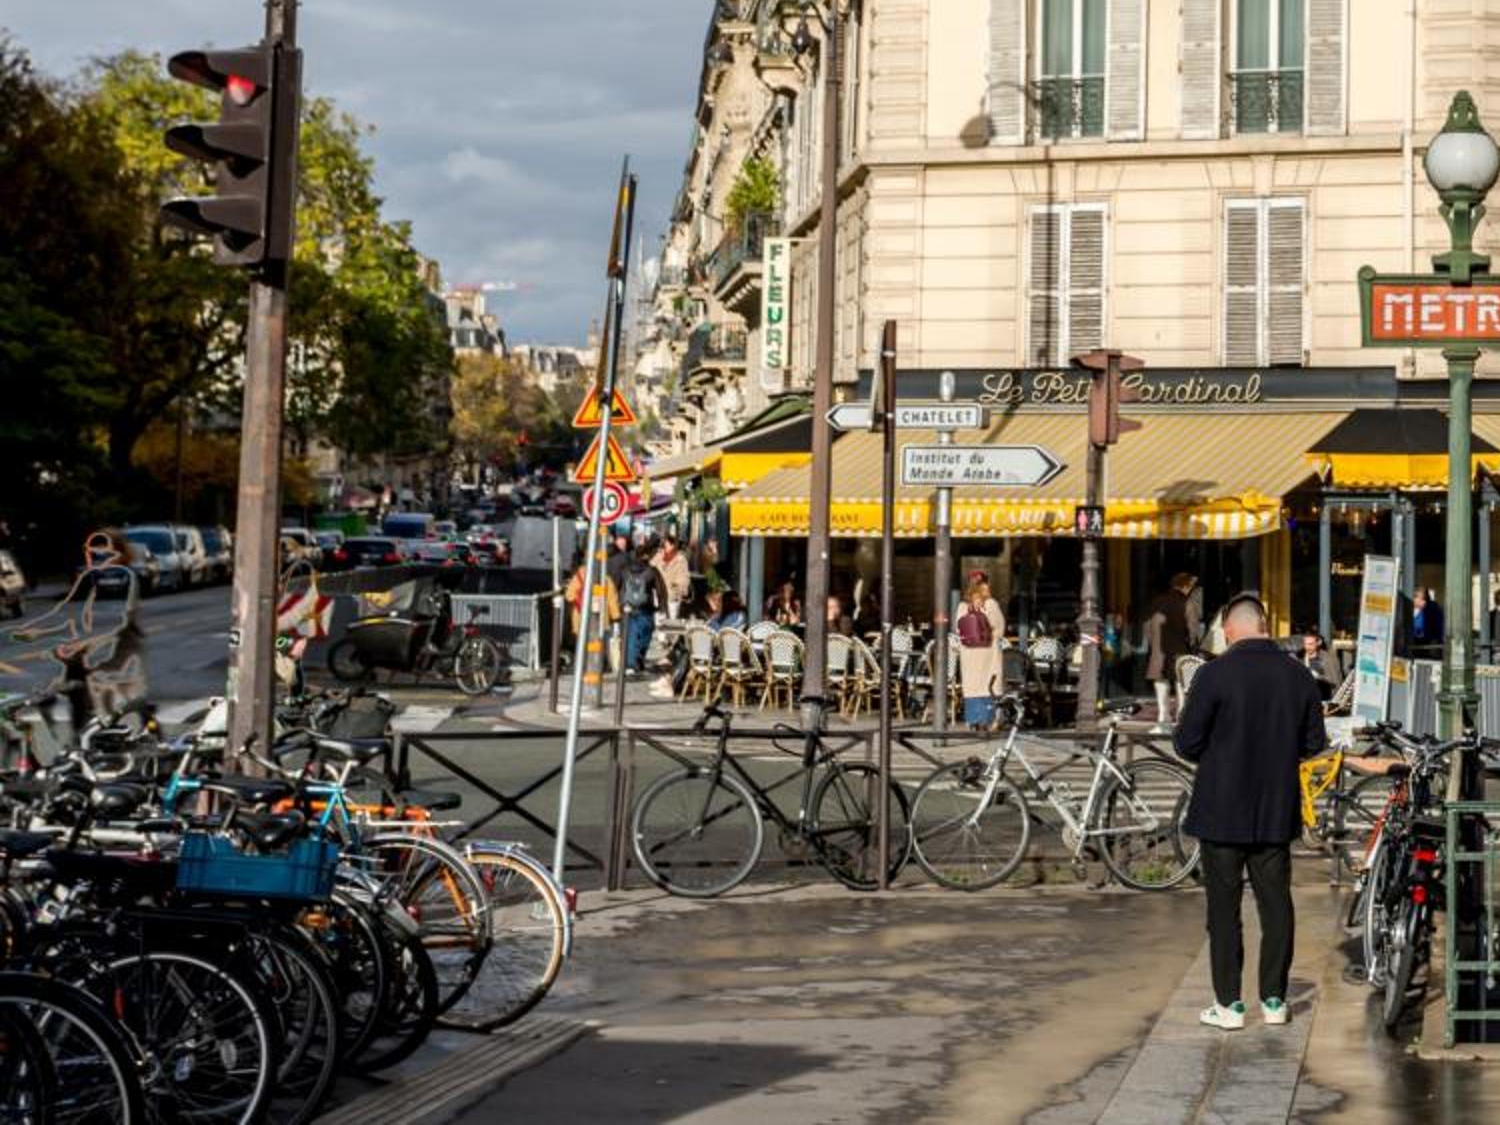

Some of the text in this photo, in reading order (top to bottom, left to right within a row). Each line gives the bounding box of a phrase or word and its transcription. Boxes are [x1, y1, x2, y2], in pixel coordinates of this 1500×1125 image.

[766, 244, 784, 369] FLEURS
[979, 374, 1025, 403] Le
[1031, 372, 1094, 403] Peti
[901, 410, 973, 424] CHATELET
[910, 452, 985, 465] Institut du
[909, 467, 954, 480] Monde
